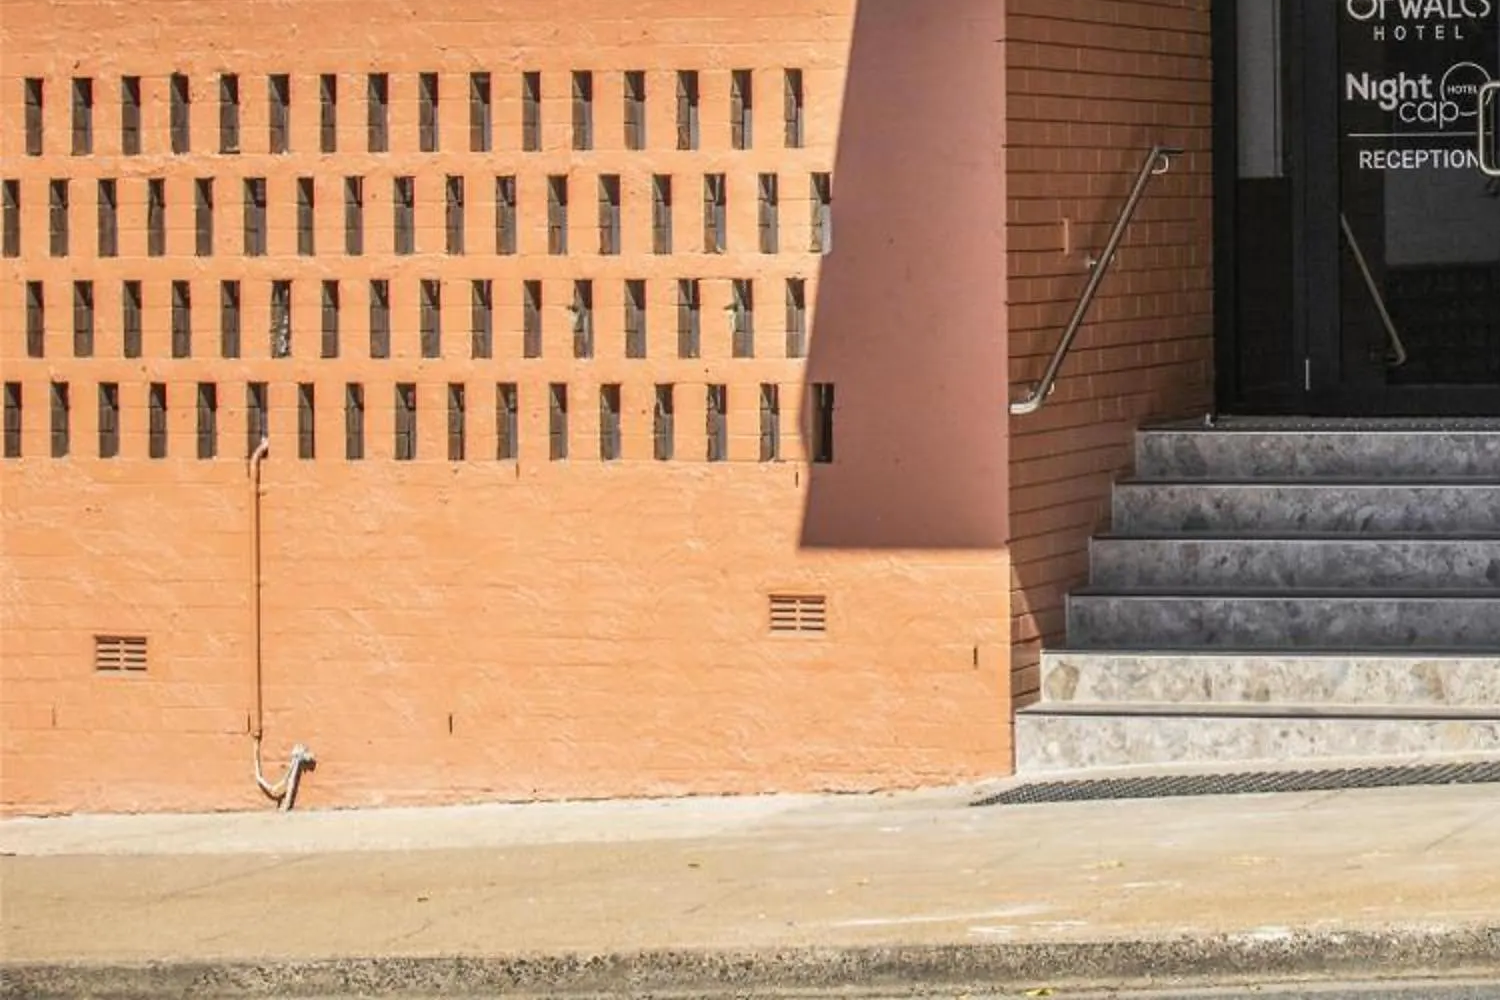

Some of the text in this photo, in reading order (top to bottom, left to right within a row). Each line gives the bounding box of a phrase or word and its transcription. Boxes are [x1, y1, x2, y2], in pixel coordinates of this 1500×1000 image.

[1373, 25, 1464, 41] HOTEL
[1346, 71, 1432, 110] Night
[1399, 100, 1460, 129] cap
[1359, 149, 1479, 169] RECEPTION
